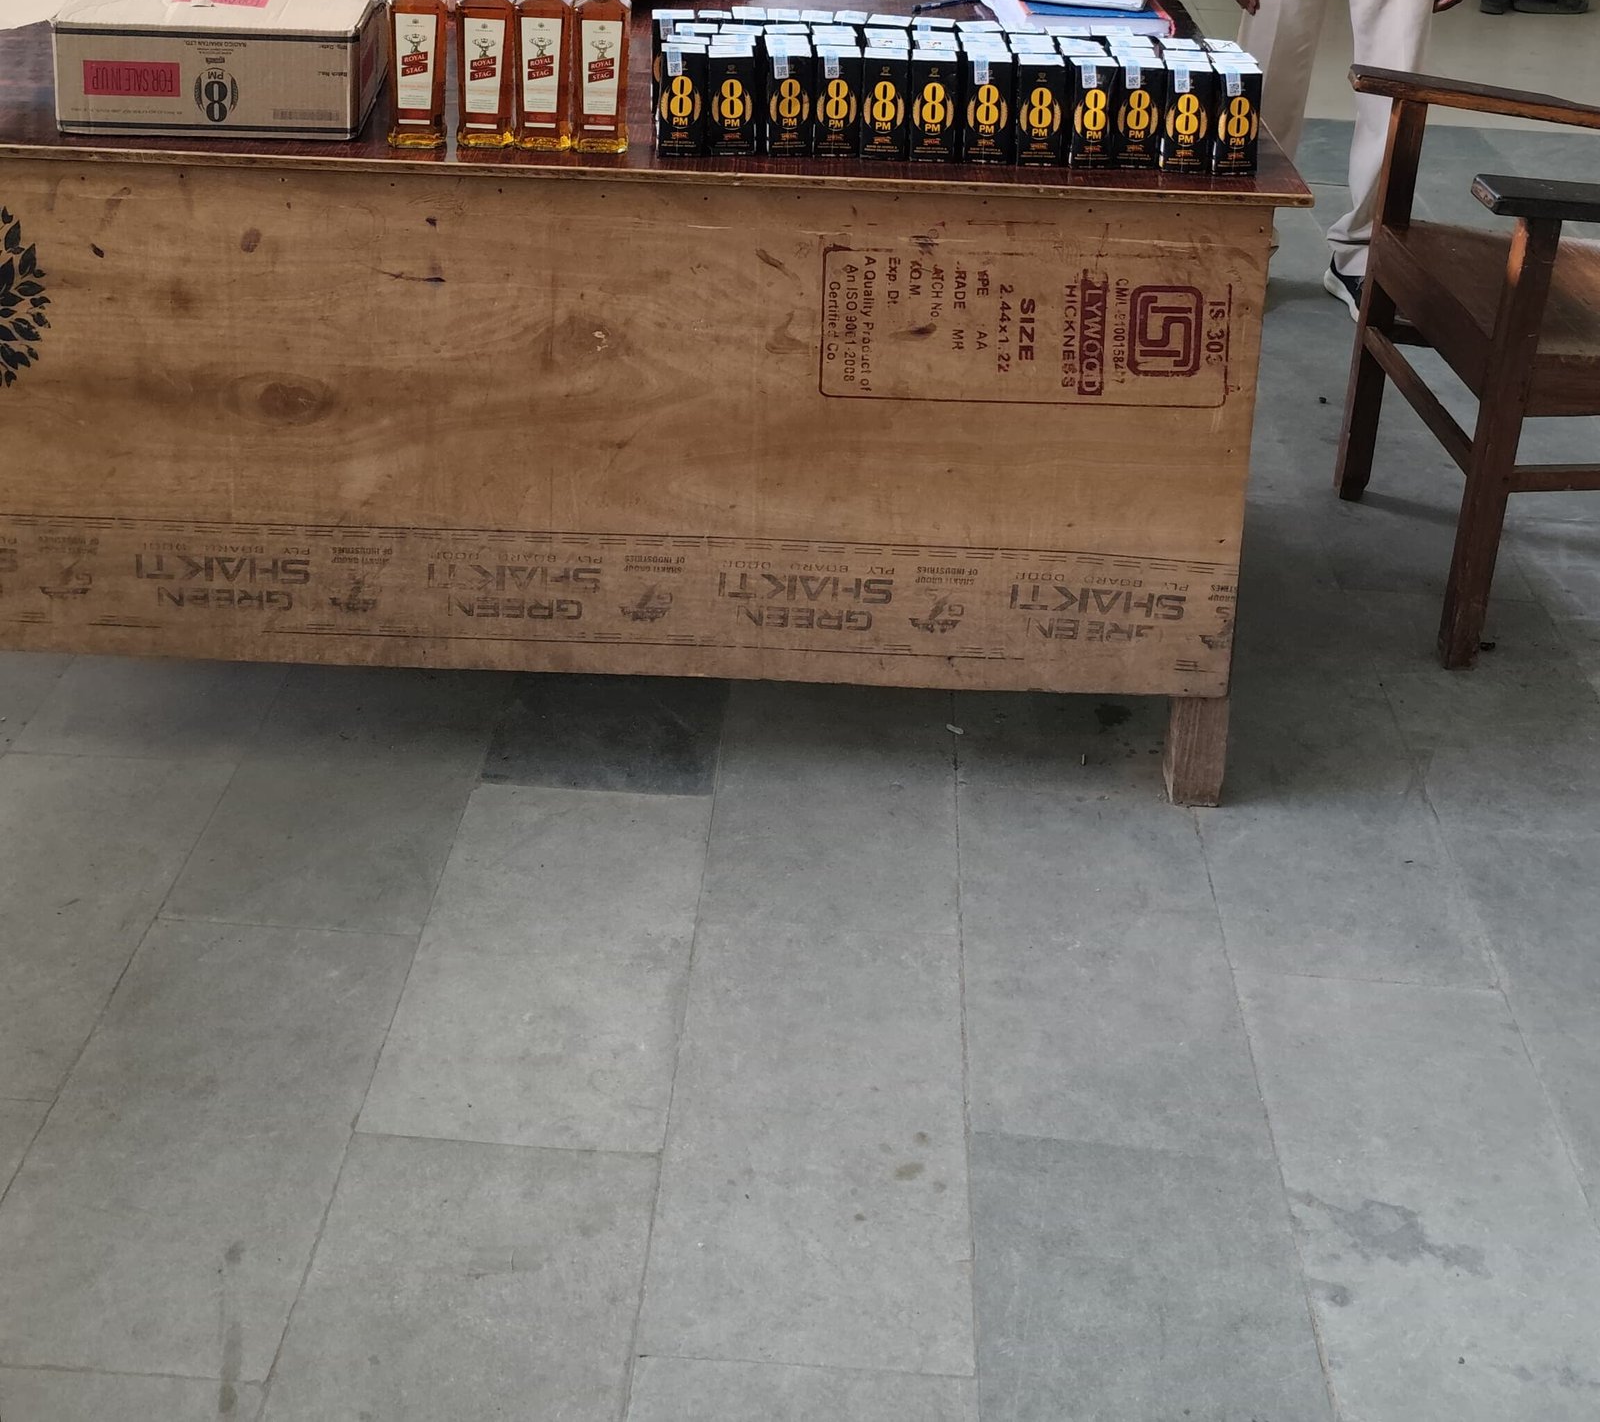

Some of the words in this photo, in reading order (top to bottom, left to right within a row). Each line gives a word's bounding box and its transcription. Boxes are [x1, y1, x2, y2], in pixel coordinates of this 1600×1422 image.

[404, 54, 425, 63] ROYAL
[472, 58, 494, 67] ROYAL
[530, 57, 552, 67] ROYAL
[590, 60, 612, 69] ROYAL
[110, 67, 122, 90] IN
[124, 67, 149, 92] SALE
[151, 67, 174, 93] FOR
[207, 70, 223, 80] PM
[406, 66, 424, 74] STAG
[474, 70, 492, 78] STAG
[532, 69, 550, 77] STAG
[592, 72, 610, 80] STAG
[205, 80, 228, 122] 8
[670, 75, 693, 117] 8
[720, 79, 744, 119] 8
[779, 78, 800, 119] 8
[826, 79, 849, 119] 8
[872, 81, 896, 122] 8
[921, 82, 945, 124] 8
[976, 84, 999, 125] 8
[1029, 87, 1052, 128] 8
[1083, 88, 1107, 131] 8
[1126, 89, 1150, 130] 8
[1175, 93, 1199, 135] 8
[1227, 97, 1250, 137] 8
[673, 117, 689, 127] PM
[724, 118, 740, 128] PM
[782, 118, 797, 127] PM
[828, 119, 844, 129] PM
[875, 121, 891, 131] PM
[924, 123, 941, 133] PM
[979, 124, 994, 134] PM
[1032, 128, 1048, 138] PM
[1086, 130, 1102, 140] PM
[1129, 130, 1144, 139] PM
[1178, 134, 1194, 144] PM
[1230, 136, 1245, 146] PM
[865, 256, 876, 266] A
[886, 257, 901, 286] Exp.
[846, 264, 859, 283] An
[846, 287, 858, 311] ISO
[862, 270, 876, 317] Quality
[888, 290, 900, 309] Dt.
[931, 302, 943, 321] No.
[997, 284, 1014, 374] 2.44x1.22
[1018, 297, 1036, 361] SIZE
[860, 321, 874, 374] Product
[976, 330, 988, 351] AA
[826, 343, 837, 365] Co.
[860, 379, 872, 392] of
[135, 554, 311, 584] SHAKTI
[157, 586, 293, 611] GREEN
[719, 572, 893, 605] SHAKTI
[448, 594, 582, 621] GREEN
[1009, 584, 1187, 621] SHAKTI
[736, 605, 873, 632] GREEN
